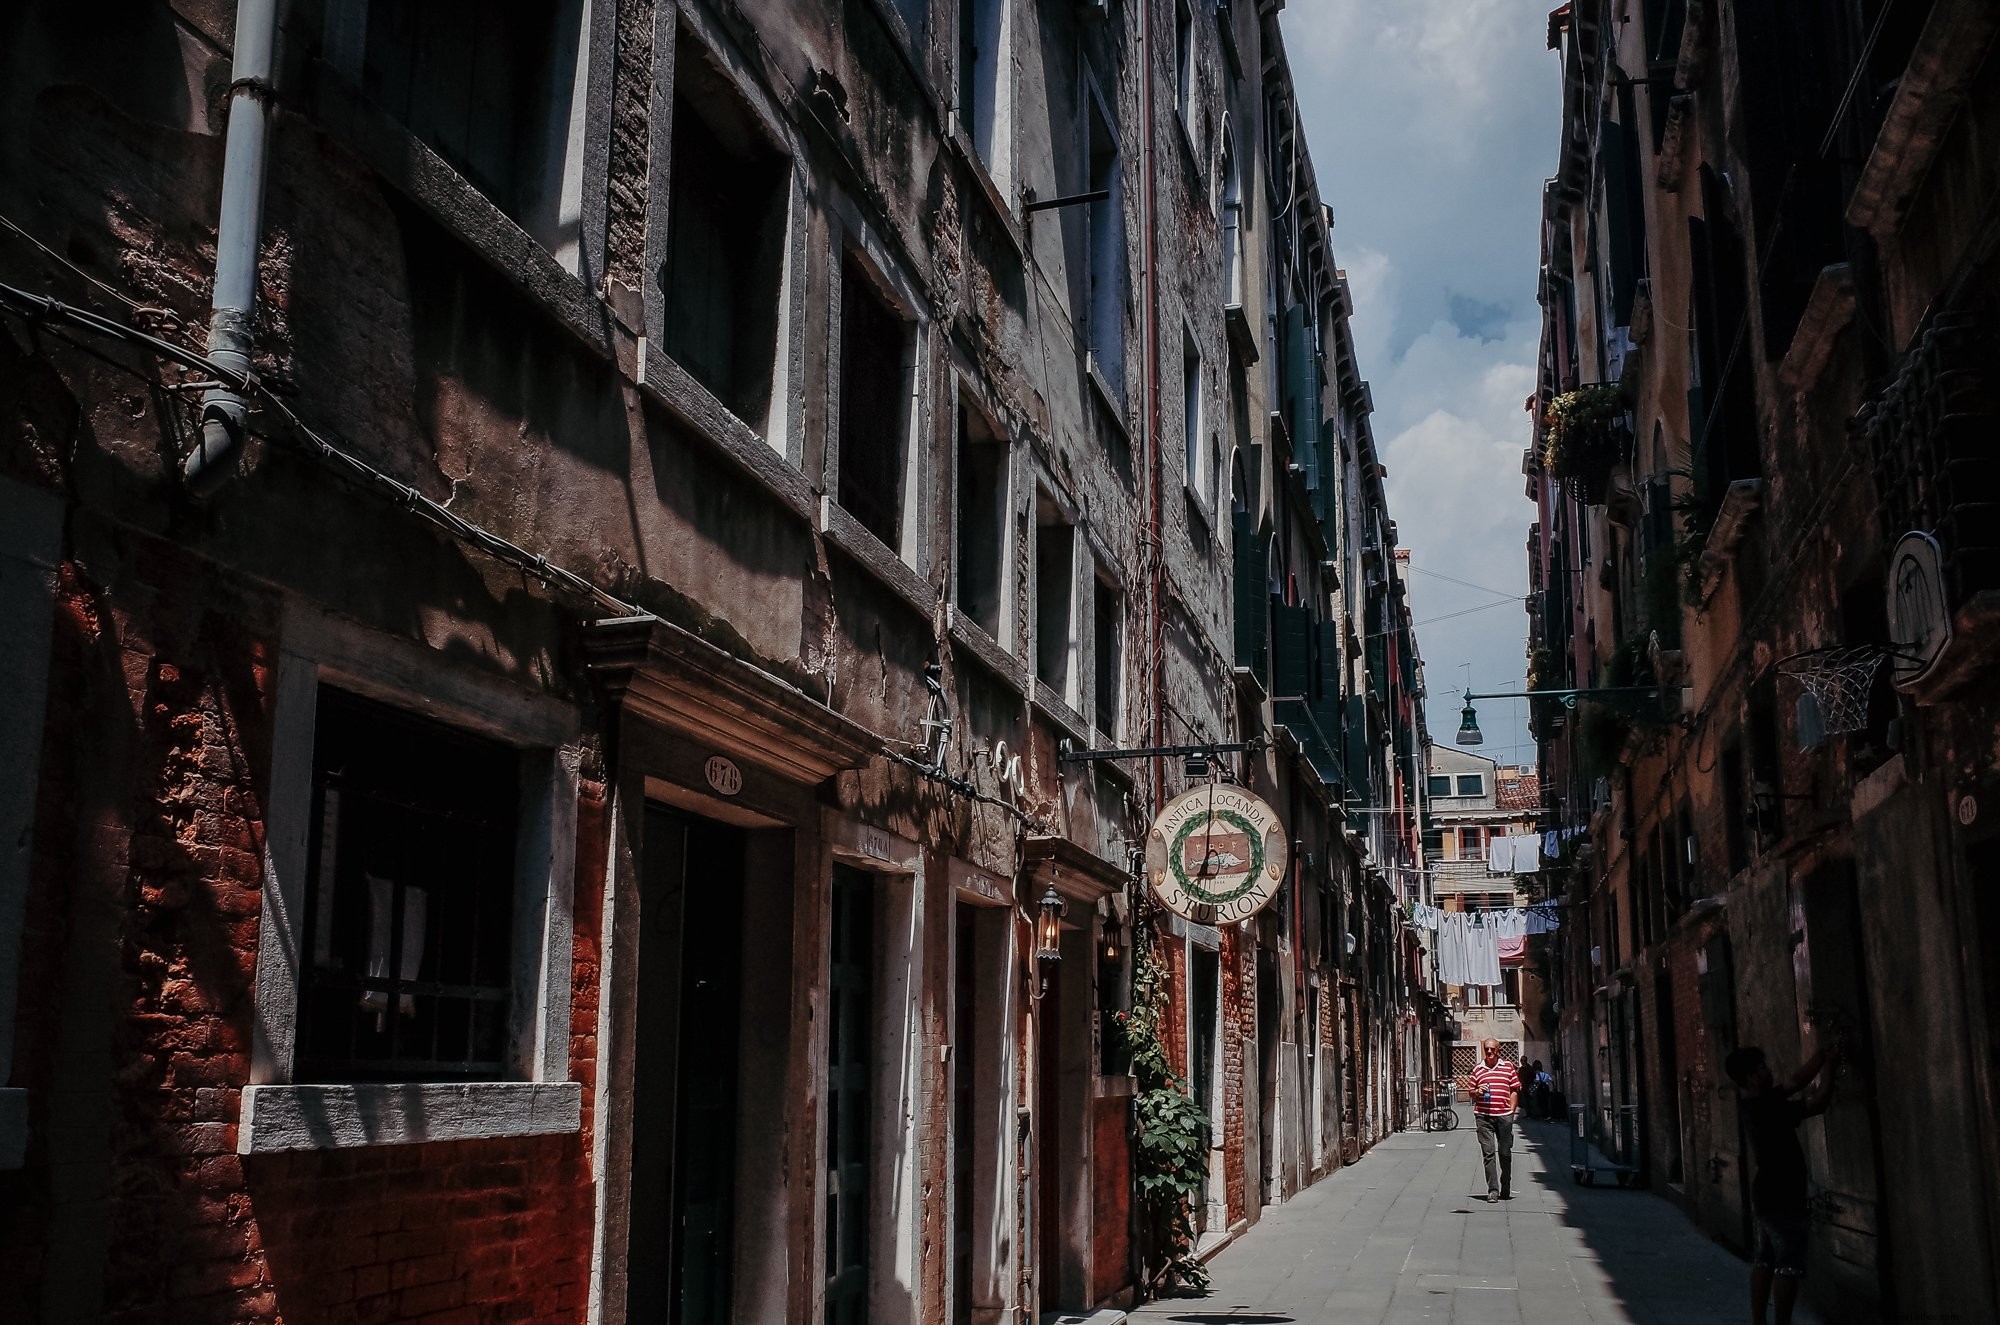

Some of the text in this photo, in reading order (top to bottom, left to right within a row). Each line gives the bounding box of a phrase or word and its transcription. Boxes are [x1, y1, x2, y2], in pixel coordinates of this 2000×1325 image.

[709, 759, 737, 790] 678
[1164, 794, 1265, 833] ANTICA LOCANDA
[1166, 884, 1269, 921] STURION
